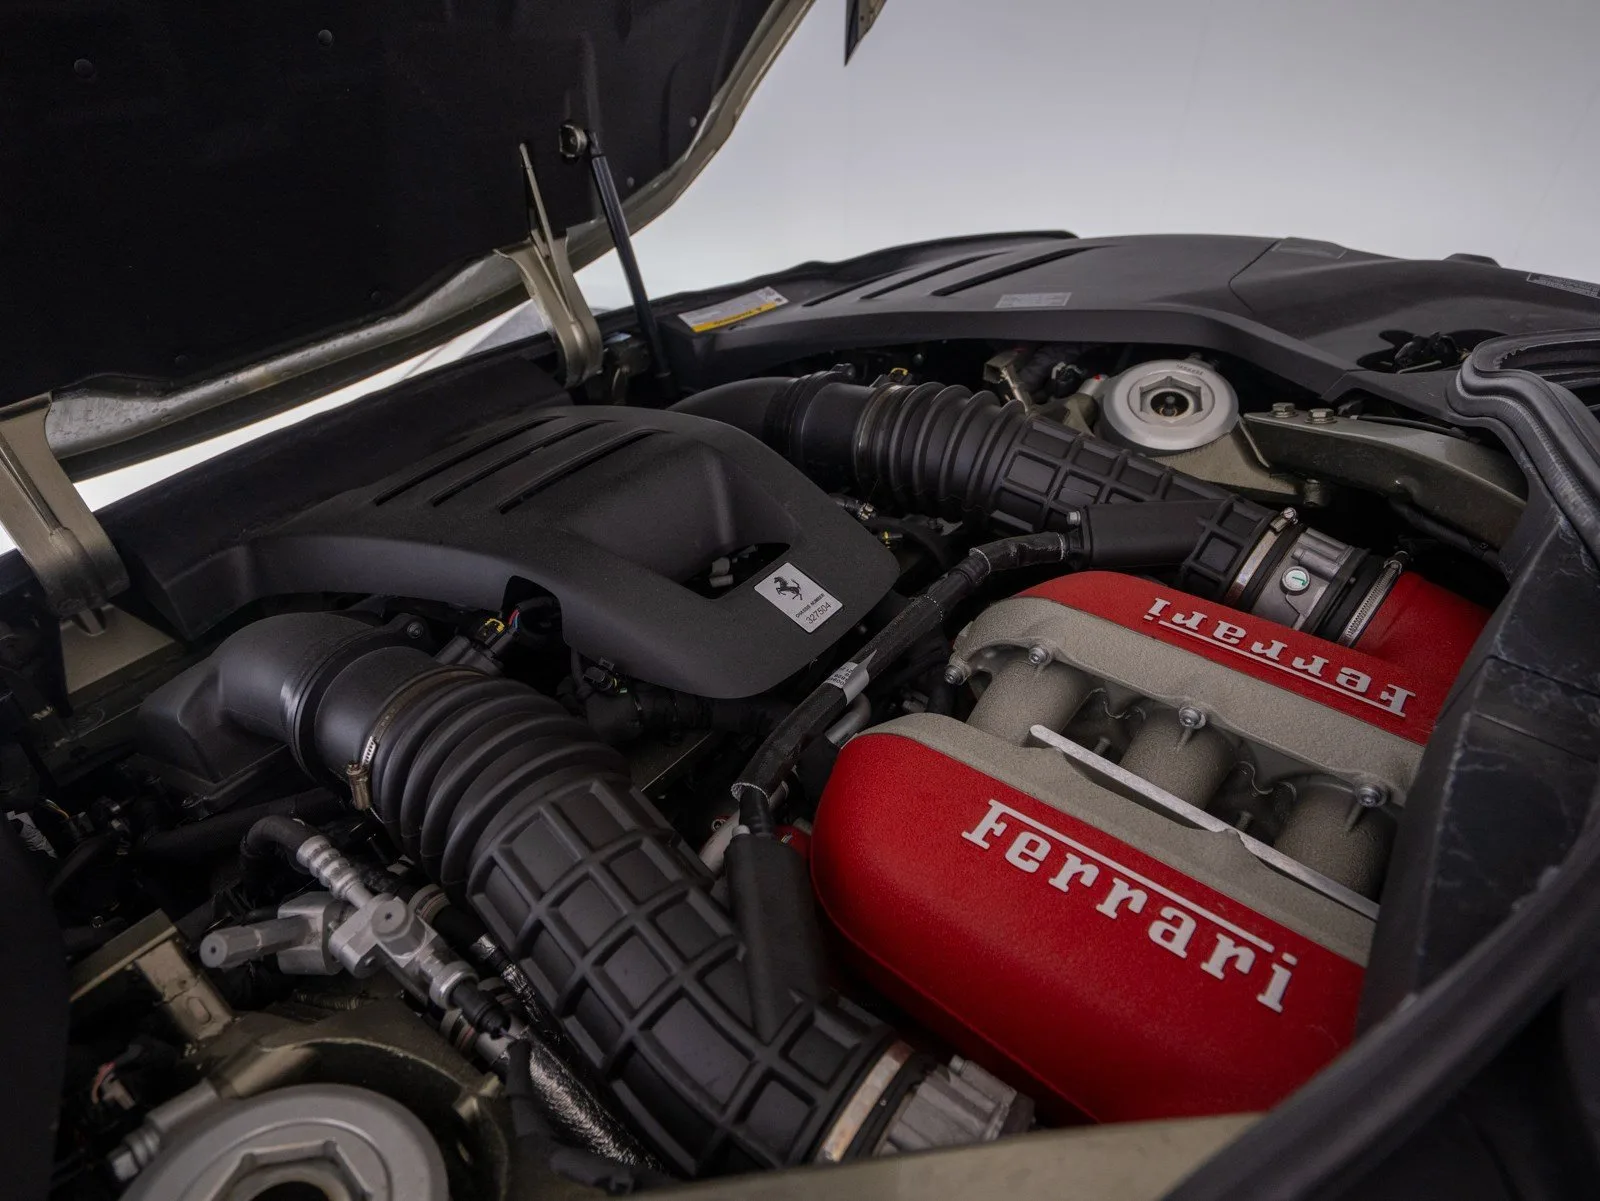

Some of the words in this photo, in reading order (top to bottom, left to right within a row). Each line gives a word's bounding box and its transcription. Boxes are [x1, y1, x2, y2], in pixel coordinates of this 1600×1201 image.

[805, 601, 832, 624] 327504
[1143, 597, 1416, 718] Ferrari
[961, 799, 1298, 1014] Ferrari
